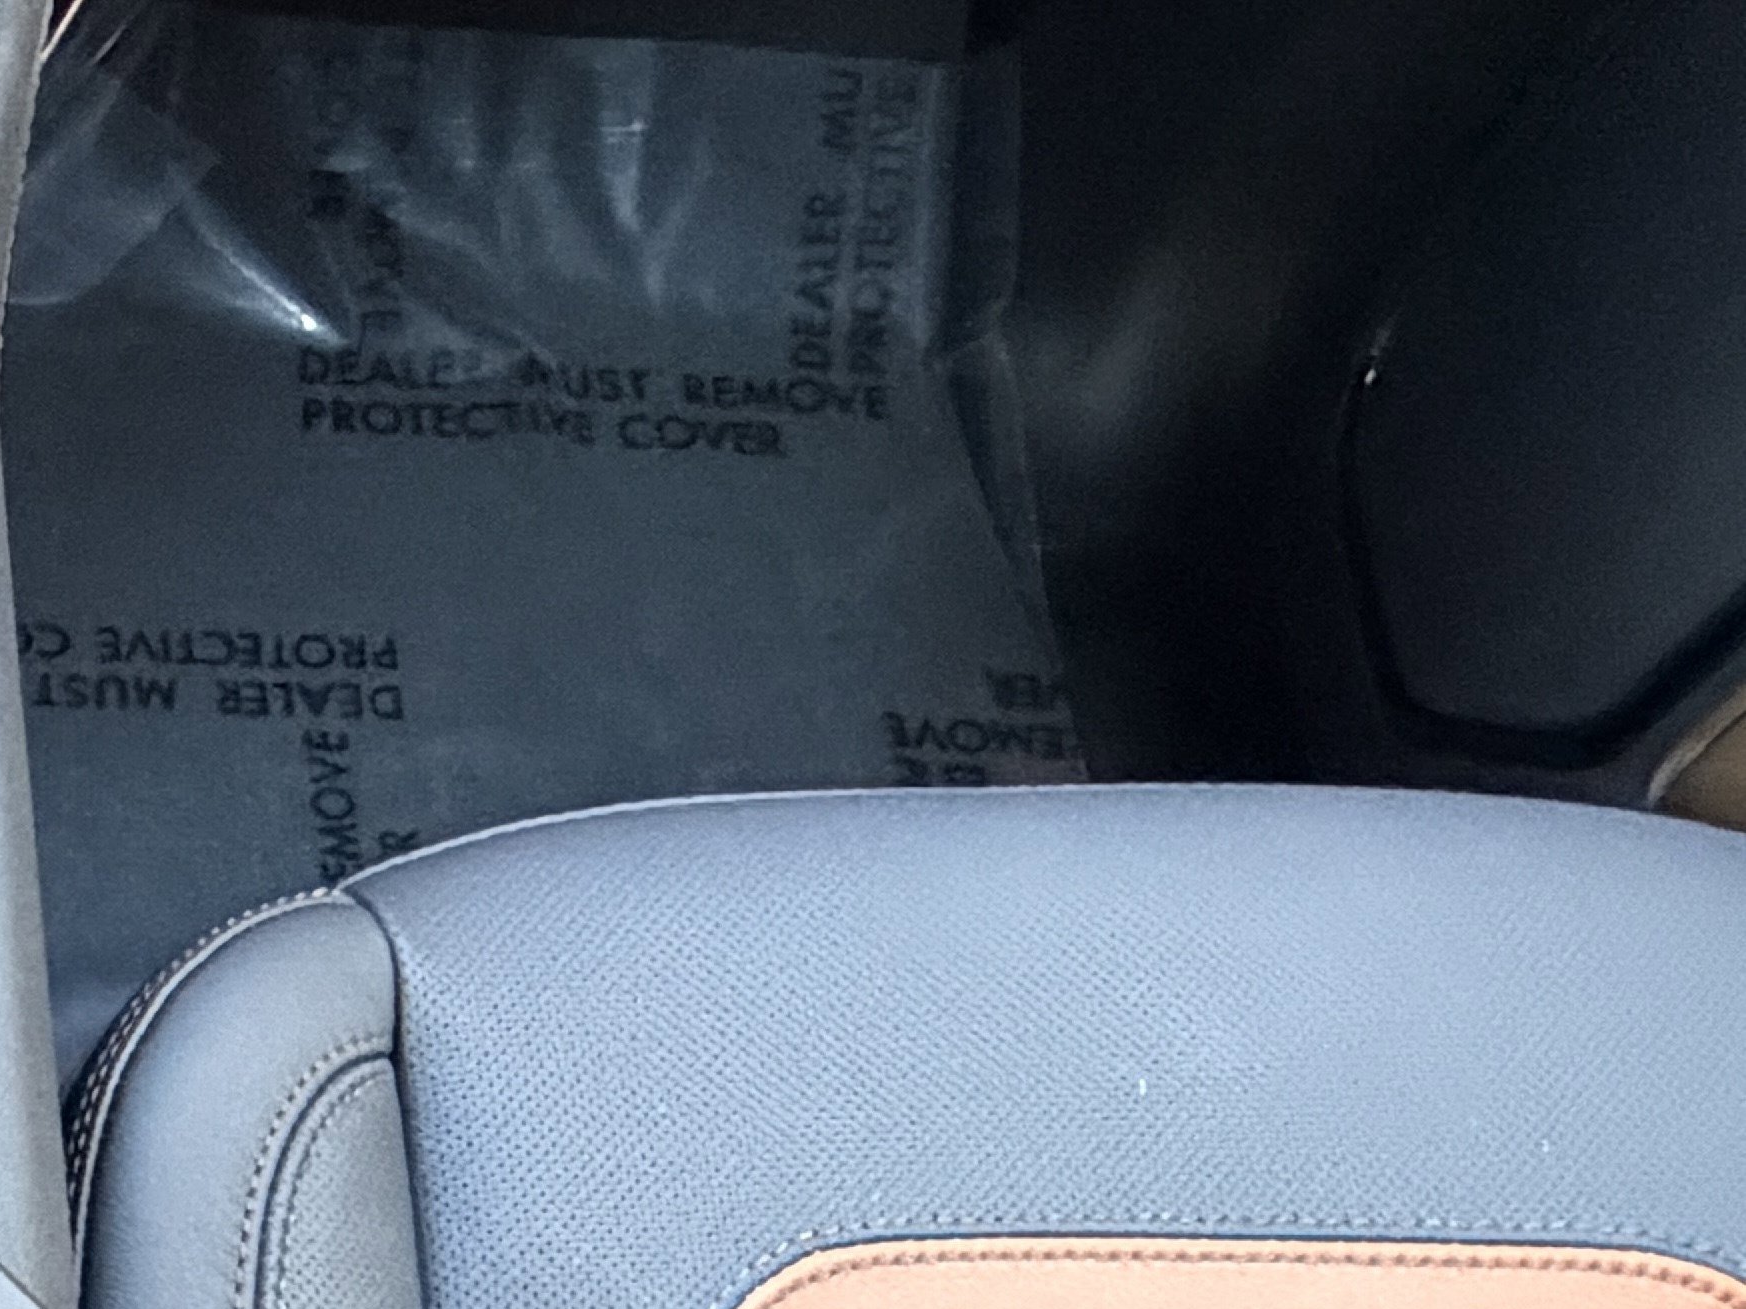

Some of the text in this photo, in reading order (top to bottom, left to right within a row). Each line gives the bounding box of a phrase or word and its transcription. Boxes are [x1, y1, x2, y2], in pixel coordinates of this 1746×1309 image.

[93, 625, 400, 671] PROTECTIVE
[31, 672, 405, 723] DEALER MUST
[302, 728, 364, 884] EMOVE
